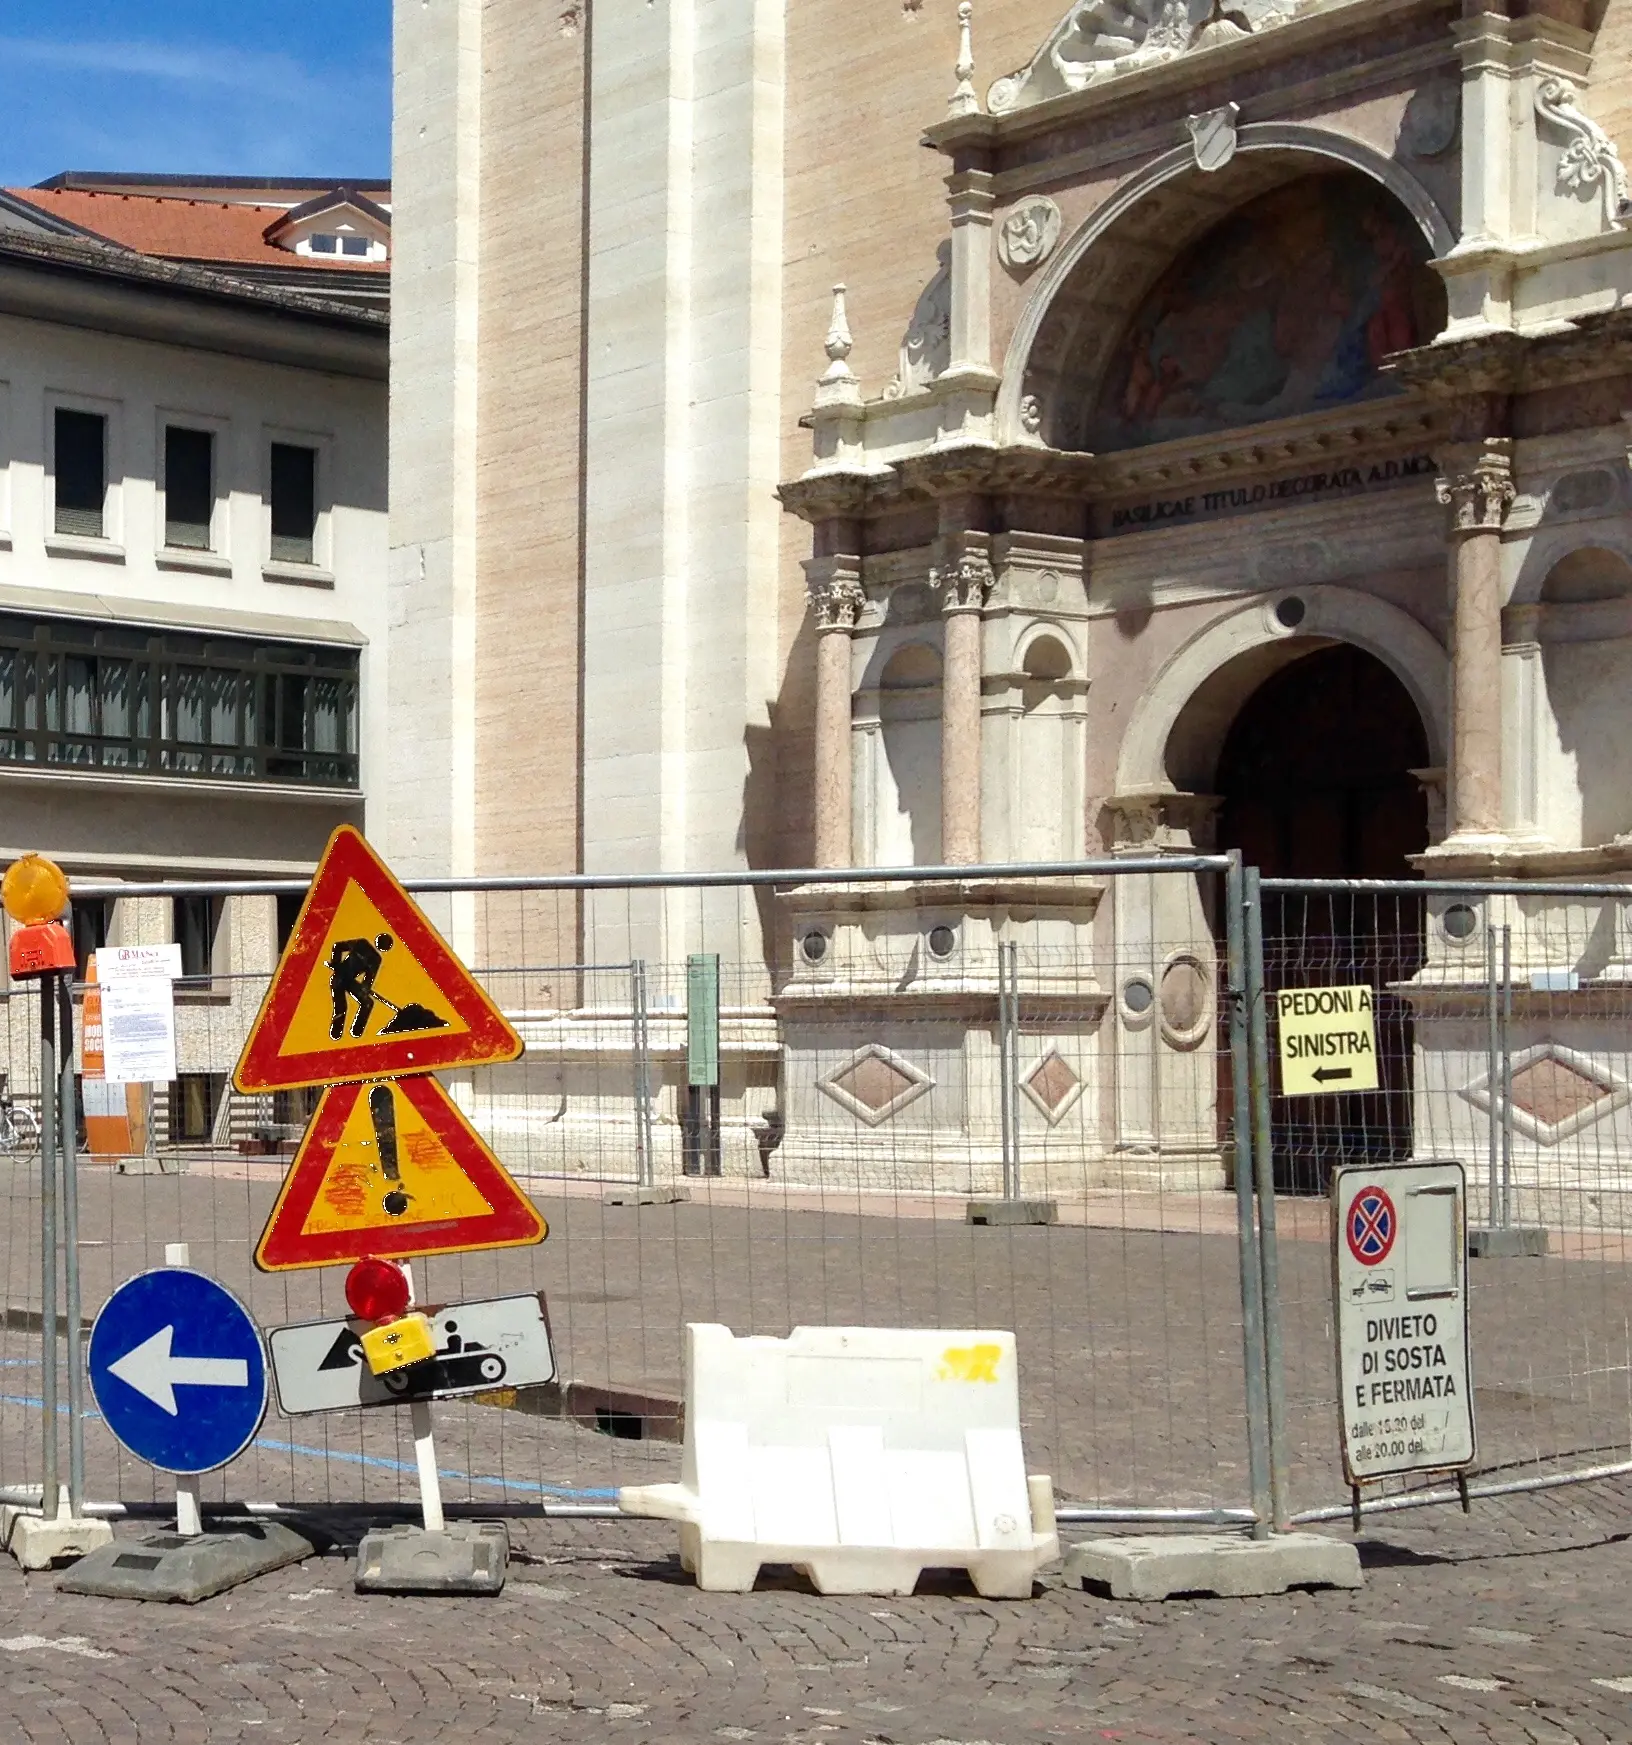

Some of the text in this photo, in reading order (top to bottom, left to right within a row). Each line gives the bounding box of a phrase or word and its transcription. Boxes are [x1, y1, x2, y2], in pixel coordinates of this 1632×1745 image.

[1111, 495, 1195, 528] BASILICAE
[1200, 484, 1266, 512] TITULO
[1269, 466, 1363, 500] DECORATA
[1279, 988, 1372, 1017] PEDONI A
[1286, 1029, 1372, 1058] SINISTRA
[1367, 1313, 1438, 1343] DIVIETO
[1362, 1344, 1447, 1375] DI SOSTA
[1355, 1374, 1457, 1408] E FERMATA
[1351, 1419, 1374, 1439] dalle
[1410, 1413, 1426, 1431] del
[1355, 1445, 1372, 1462] alle
[1408, 1437, 1424, 1455] del
